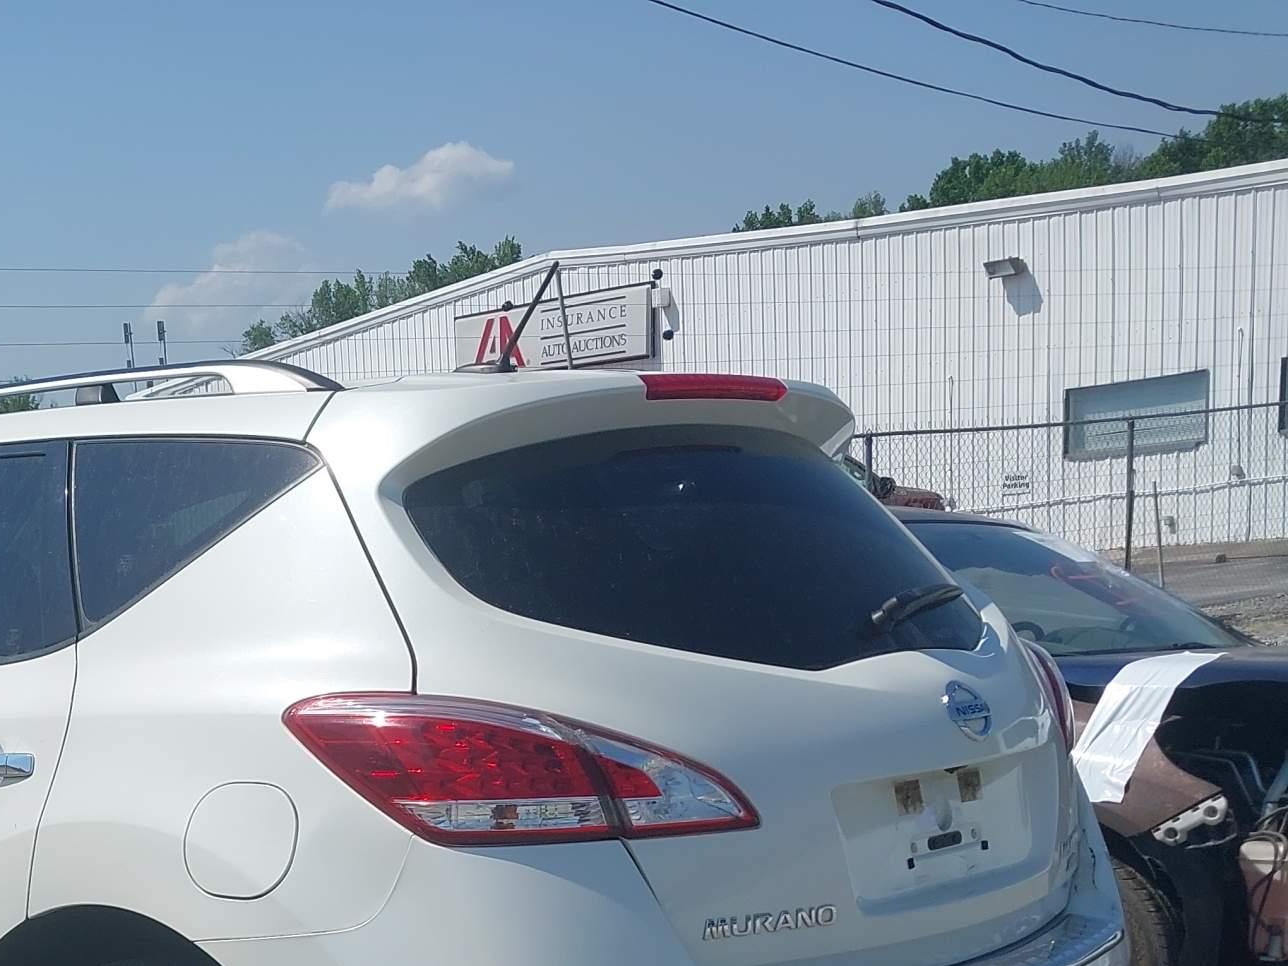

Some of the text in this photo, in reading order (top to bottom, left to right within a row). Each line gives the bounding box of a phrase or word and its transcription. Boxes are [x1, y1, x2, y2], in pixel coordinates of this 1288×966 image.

[540, 304, 627, 331] INSURANCE
[541, 333, 627, 358] AUTO AUCTIONS
[701, 904, 838, 941] MURANO
